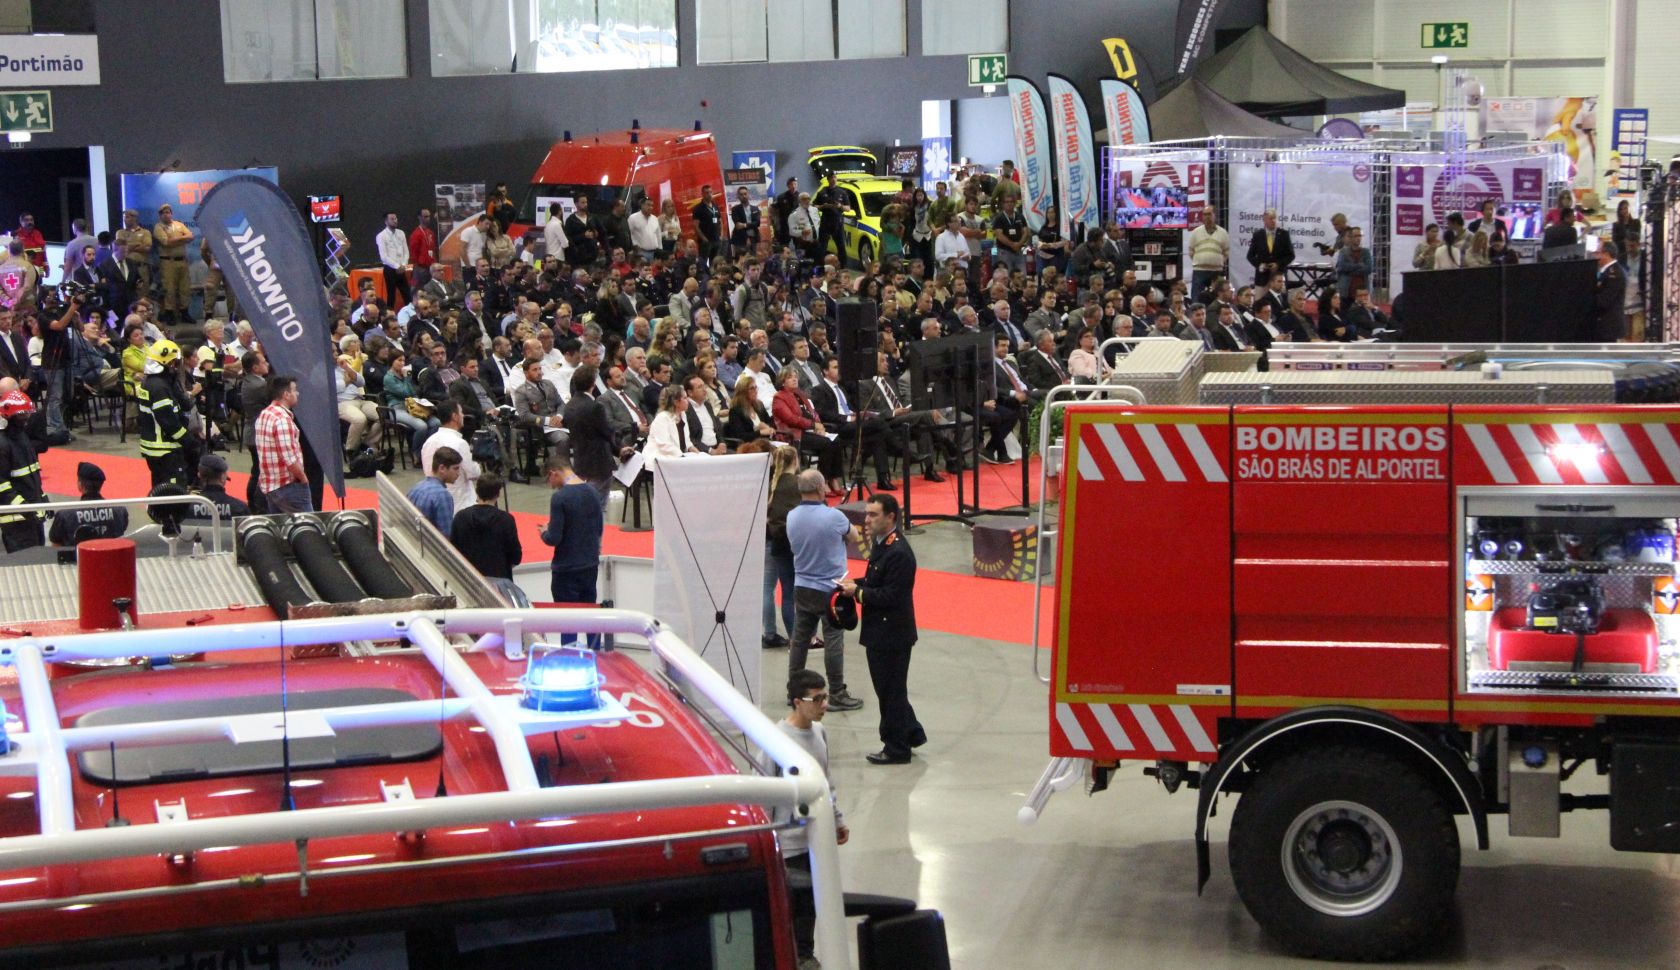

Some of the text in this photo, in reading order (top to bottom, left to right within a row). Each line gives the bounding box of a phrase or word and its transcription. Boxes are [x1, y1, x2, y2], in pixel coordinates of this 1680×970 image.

[0, 54, 84, 73] Portimão
[1291, 213, 1322, 223] Alarme
[1236, 426, 1447, 451] BOMBEIROS
[1238, 453, 1445, 480] SÃO BRÁS DE ALPORTEL
[193, 501, 231, 516] POLCIA
